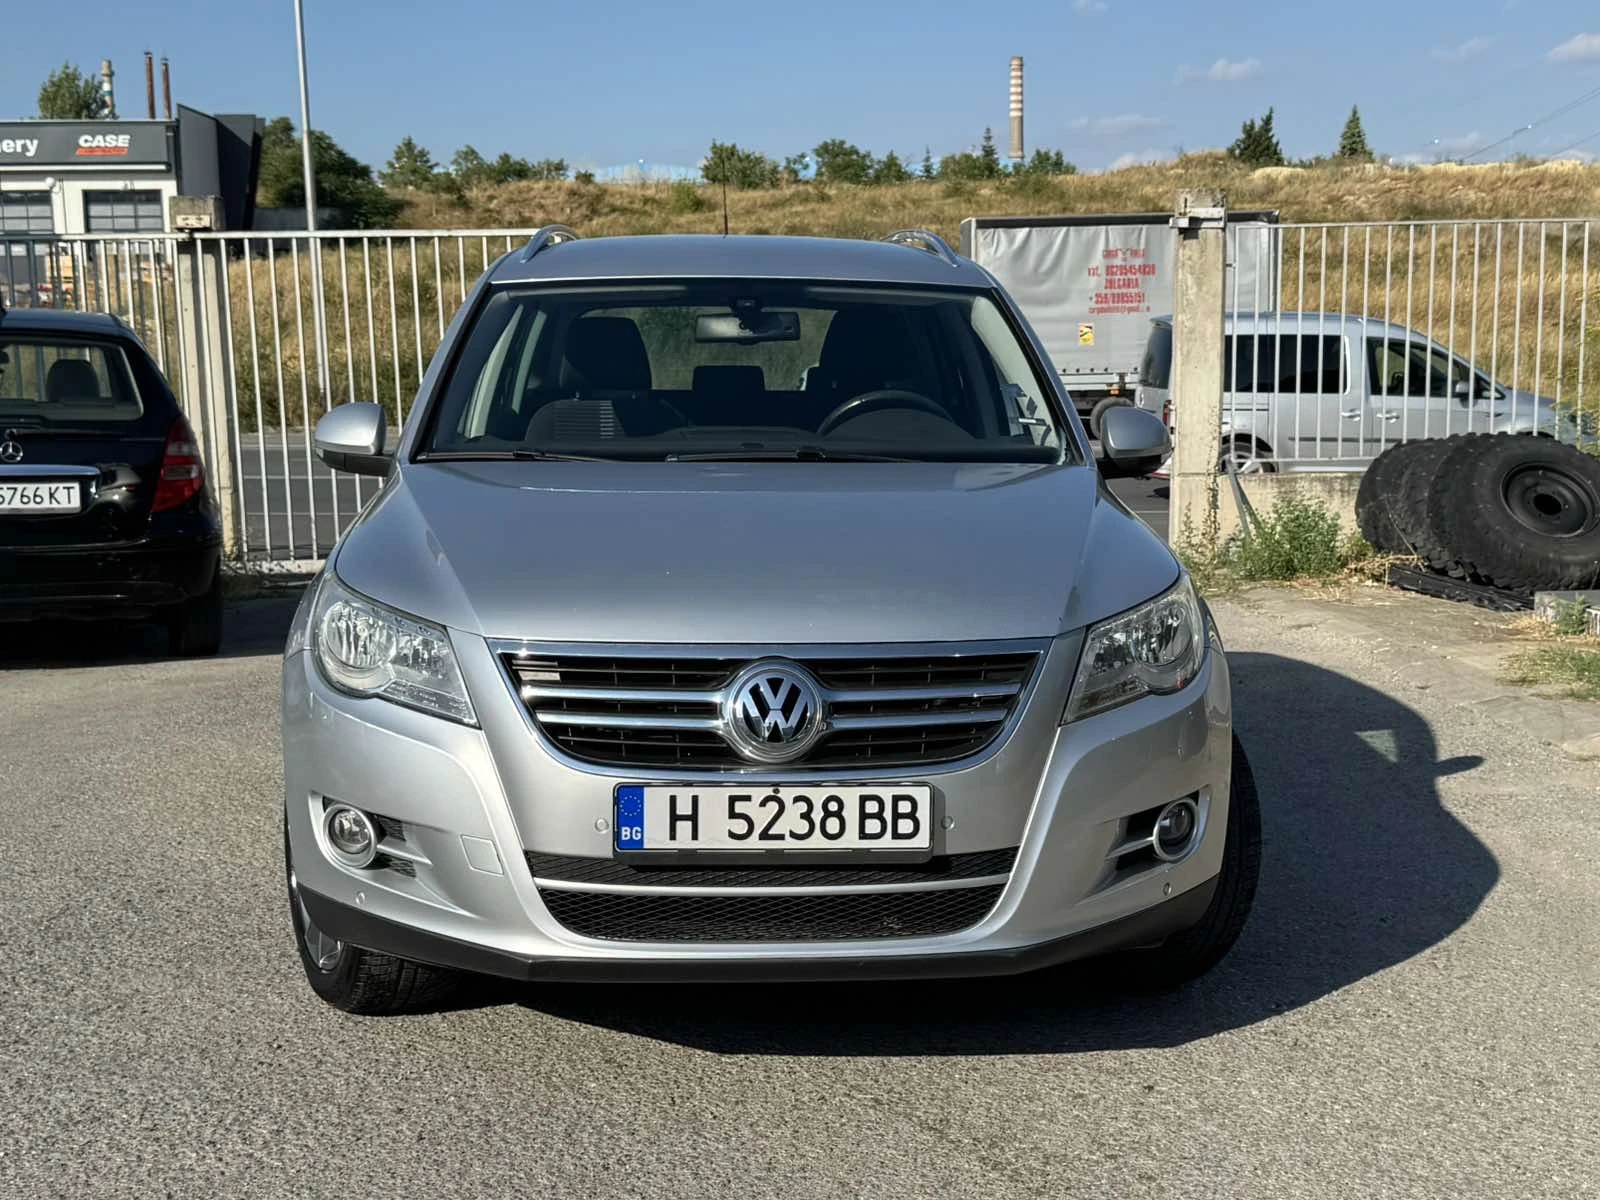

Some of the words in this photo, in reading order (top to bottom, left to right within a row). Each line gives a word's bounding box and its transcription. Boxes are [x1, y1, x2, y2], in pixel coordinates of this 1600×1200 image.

[0, 139, 38, 157] ery
[78, 134, 131, 148] CASE
[48, 486, 75, 505] KT
[733, 668, 817, 753] VW
[668, 794, 699, 841] H
[727, 794, 846, 841] 5238
[858, 794, 920, 841] BB
[621, 826, 642, 841] BG
